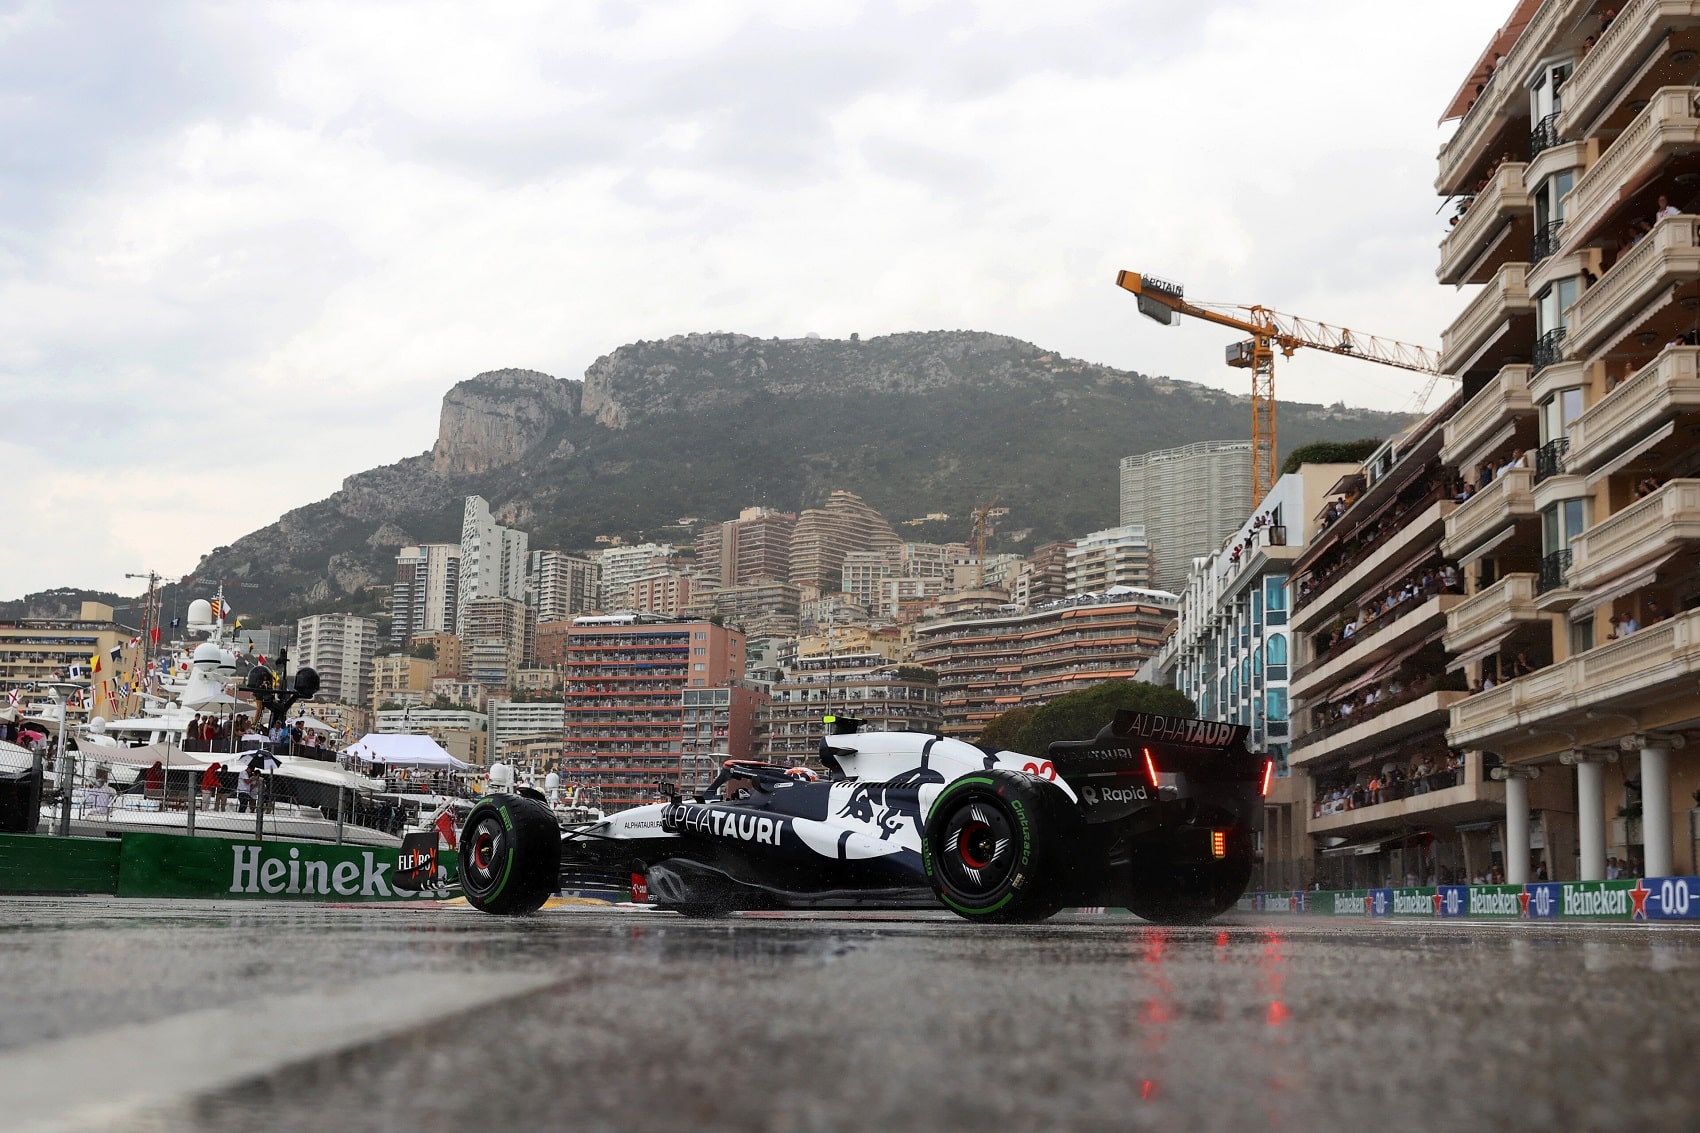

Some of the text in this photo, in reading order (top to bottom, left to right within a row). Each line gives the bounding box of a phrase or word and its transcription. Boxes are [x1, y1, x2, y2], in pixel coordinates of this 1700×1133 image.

[1128, 713, 1237, 747] ALPHATAURI
[1102, 785, 1148, 804] Rapid
[661, 803, 784, 846] ALPHATAURI
[1011, 799, 1031, 866] Cinturato
[229, 845, 449, 898] Heinek
[398, 847, 437, 881] FLEXBOX
[1334, 893, 1365, 914] Heineken
[1393, 890, 1433, 914] Heineken
[1469, 887, 1518, 915] Heineken
[1563, 880, 1689, 916] Heineken 0.0
